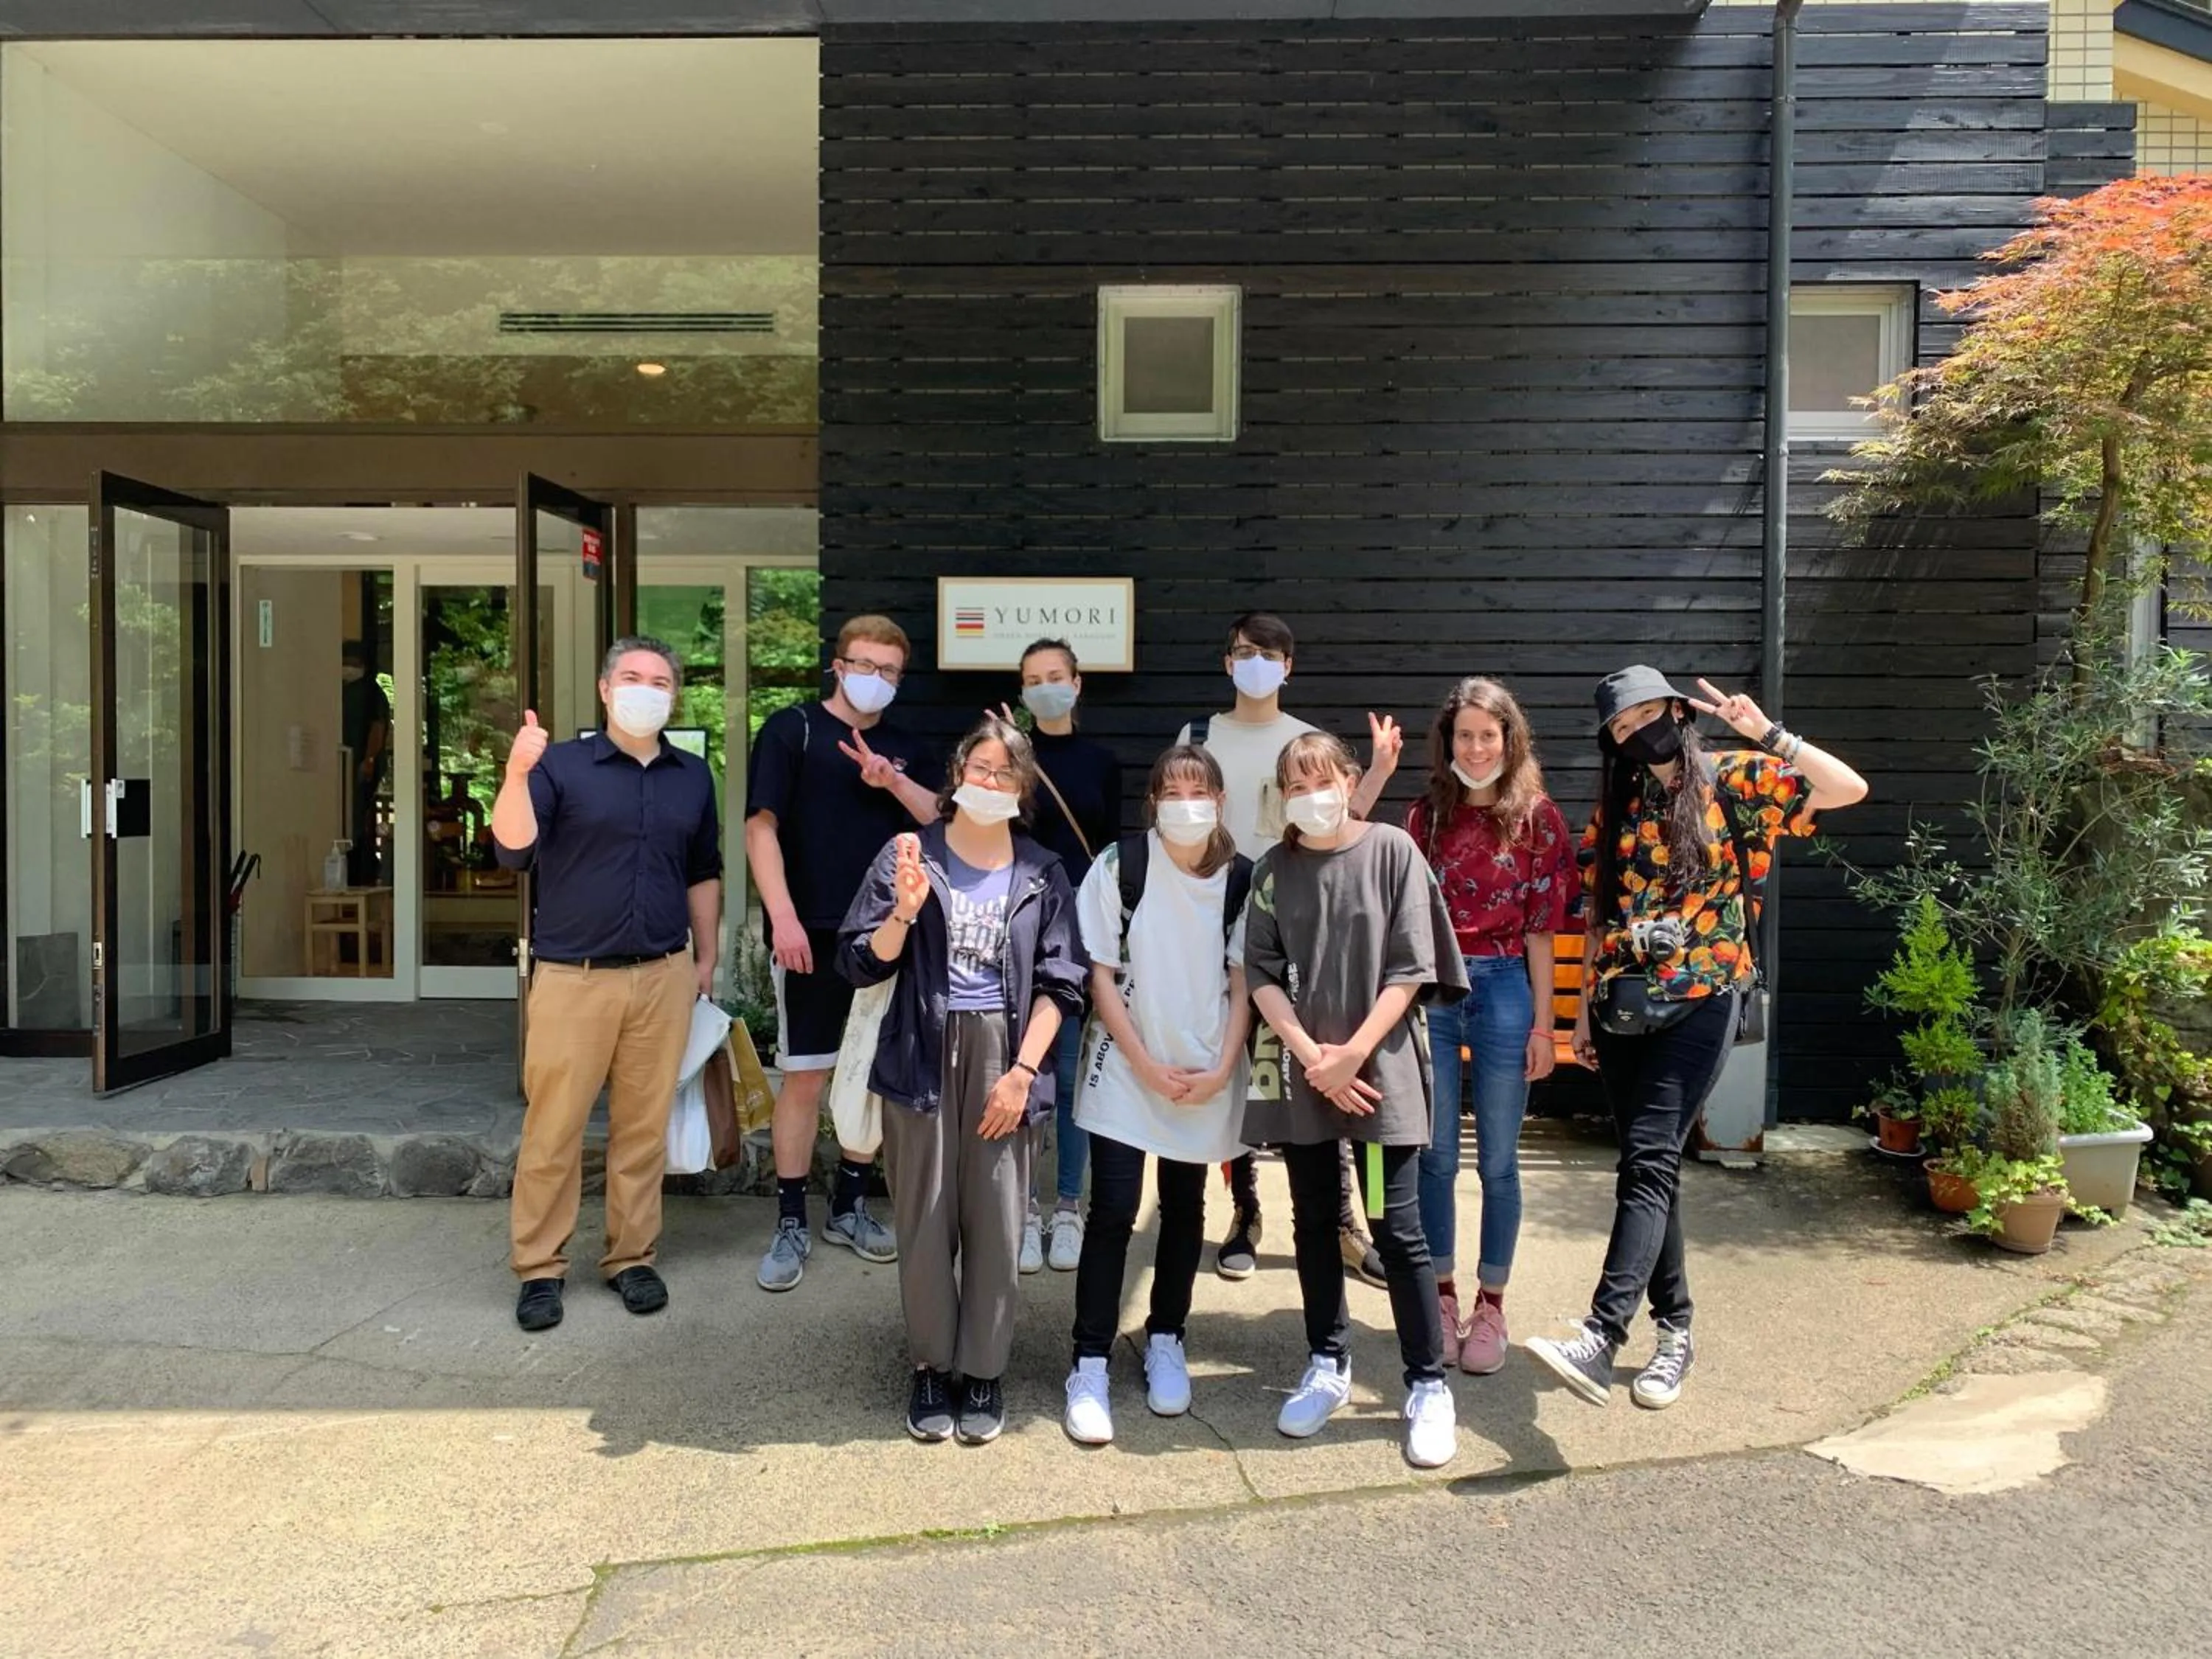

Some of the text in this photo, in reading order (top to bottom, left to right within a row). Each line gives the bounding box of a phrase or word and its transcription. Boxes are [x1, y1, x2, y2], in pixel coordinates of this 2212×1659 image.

[995, 607, 1116, 625] YUMORI
[1088, 1074, 1099, 1088] IS
[1094, 1032, 1115, 1071] ABOV
